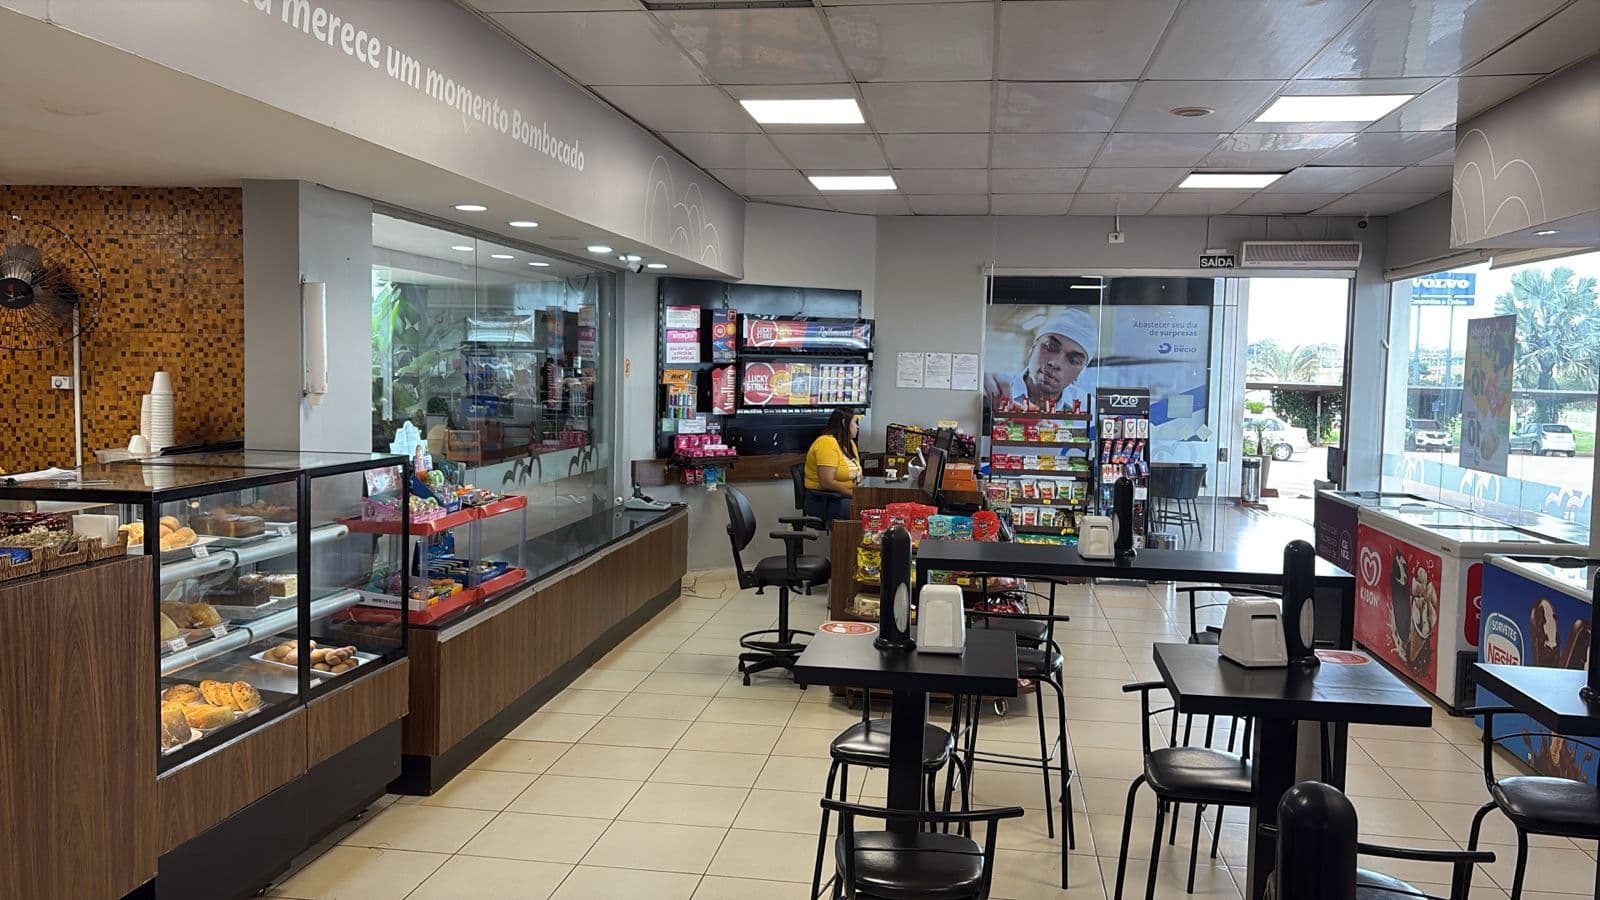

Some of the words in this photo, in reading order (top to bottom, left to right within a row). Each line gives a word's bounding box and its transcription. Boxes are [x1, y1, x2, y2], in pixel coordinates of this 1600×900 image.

[281, 0, 381, 69] merece
[386, 45, 421, 89] um
[425, 66, 509, 134] momento
[511, 108, 585, 172] Bombocado
[1201, 256, 1233, 267] SAÍDA
[1412, 278, 1470, 288] VOLVO
[1133, 321, 1170, 329] Abastecer
[1186, 321, 1198, 329] dia
[1149, 329, 1159, 337] de
[747, 374, 769, 382] LUCKY
[720, 368, 736, 411] Marlboro
[746, 382, 769, 391] STRIKE
[1360, 589, 1378, 607] KIBON
[1491, 619, 1517, 641] SORVETES
